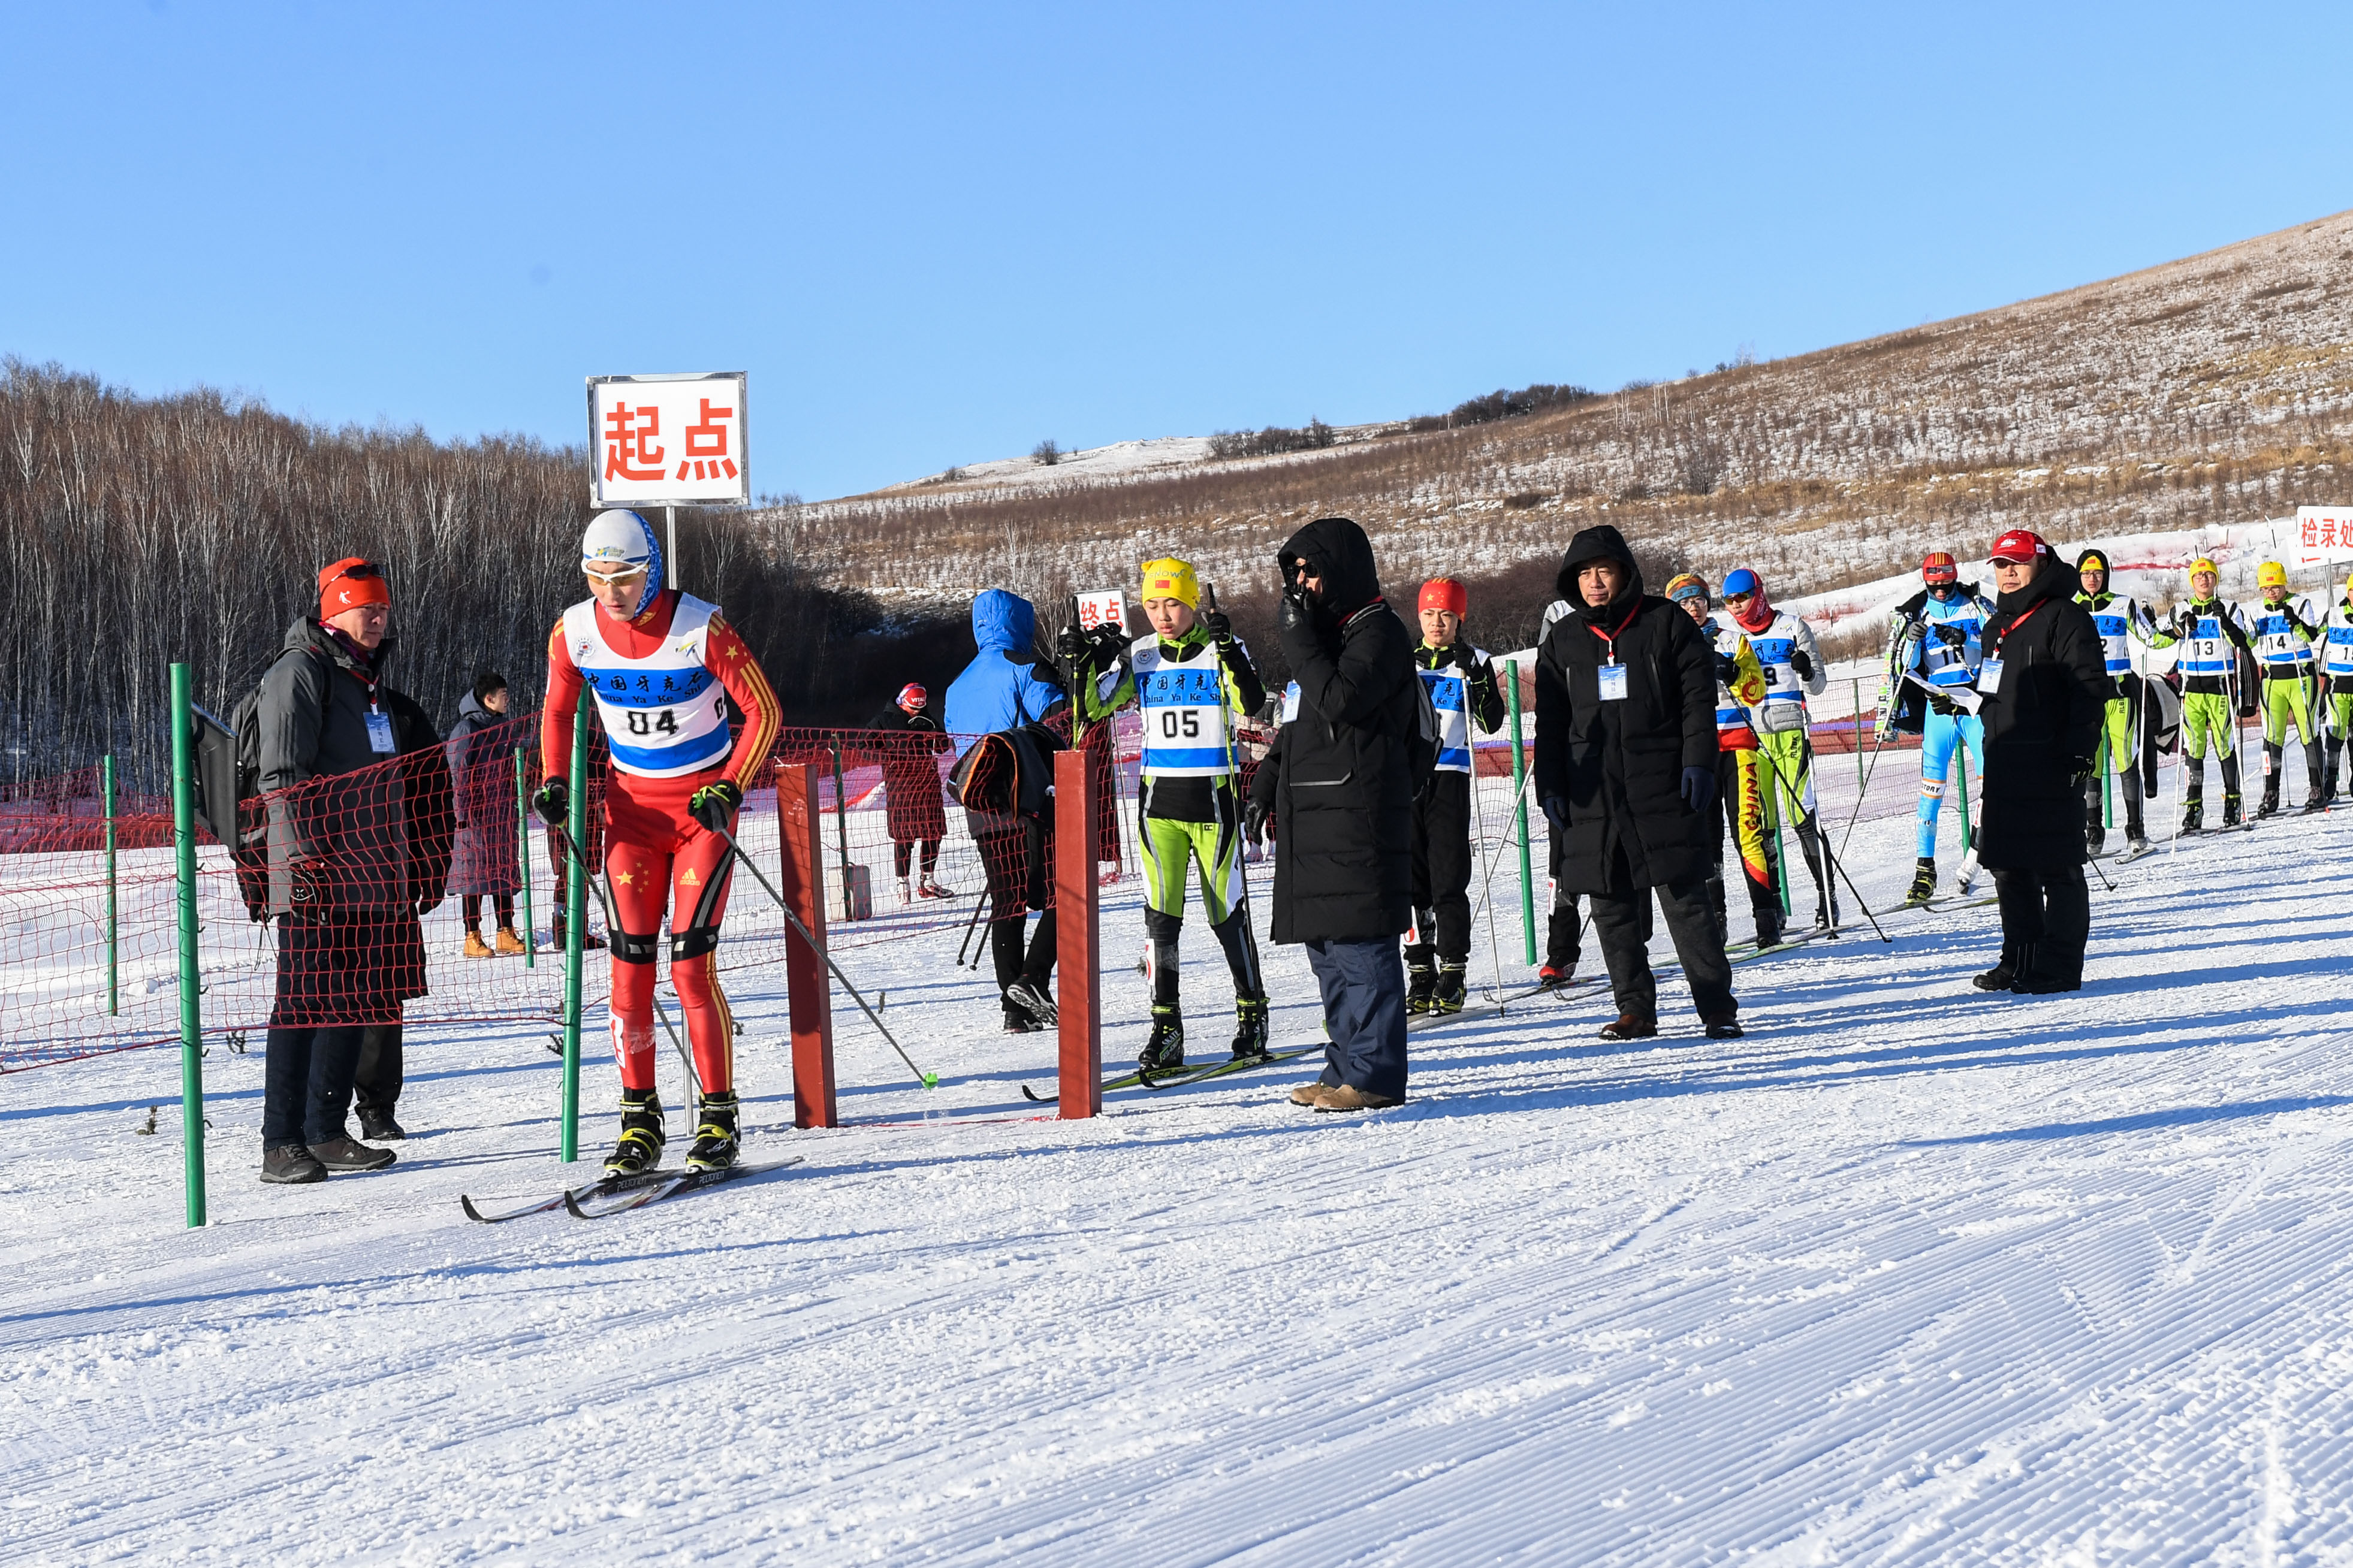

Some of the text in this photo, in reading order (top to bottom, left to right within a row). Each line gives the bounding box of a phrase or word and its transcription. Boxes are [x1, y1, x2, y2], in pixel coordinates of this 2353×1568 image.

[605, 398, 738, 482] 起点
[2301, 518, 2353, 548] 检录处
[1081, 599, 1123, 630] 终点
[2195, 641, 2213, 655] 13
[2268, 635, 2286, 650] 14
[2344, 647, 2353, 660] 1
[589, 671, 702, 692] 中国牙克石
[684, 685, 701, 698] Shi
[1171, 693, 1181, 702] Ya
[1190, 693, 1201, 701] Ke
[1209, 693, 1220, 701] Sh
[1436, 697, 1447, 705] Ke
[627, 709, 678, 736] 04
[1162, 710, 1199, 738] 05
[1745, 762, 1760, 830] CHINA
[1162, 1029, 1181, 1045] SKATE
